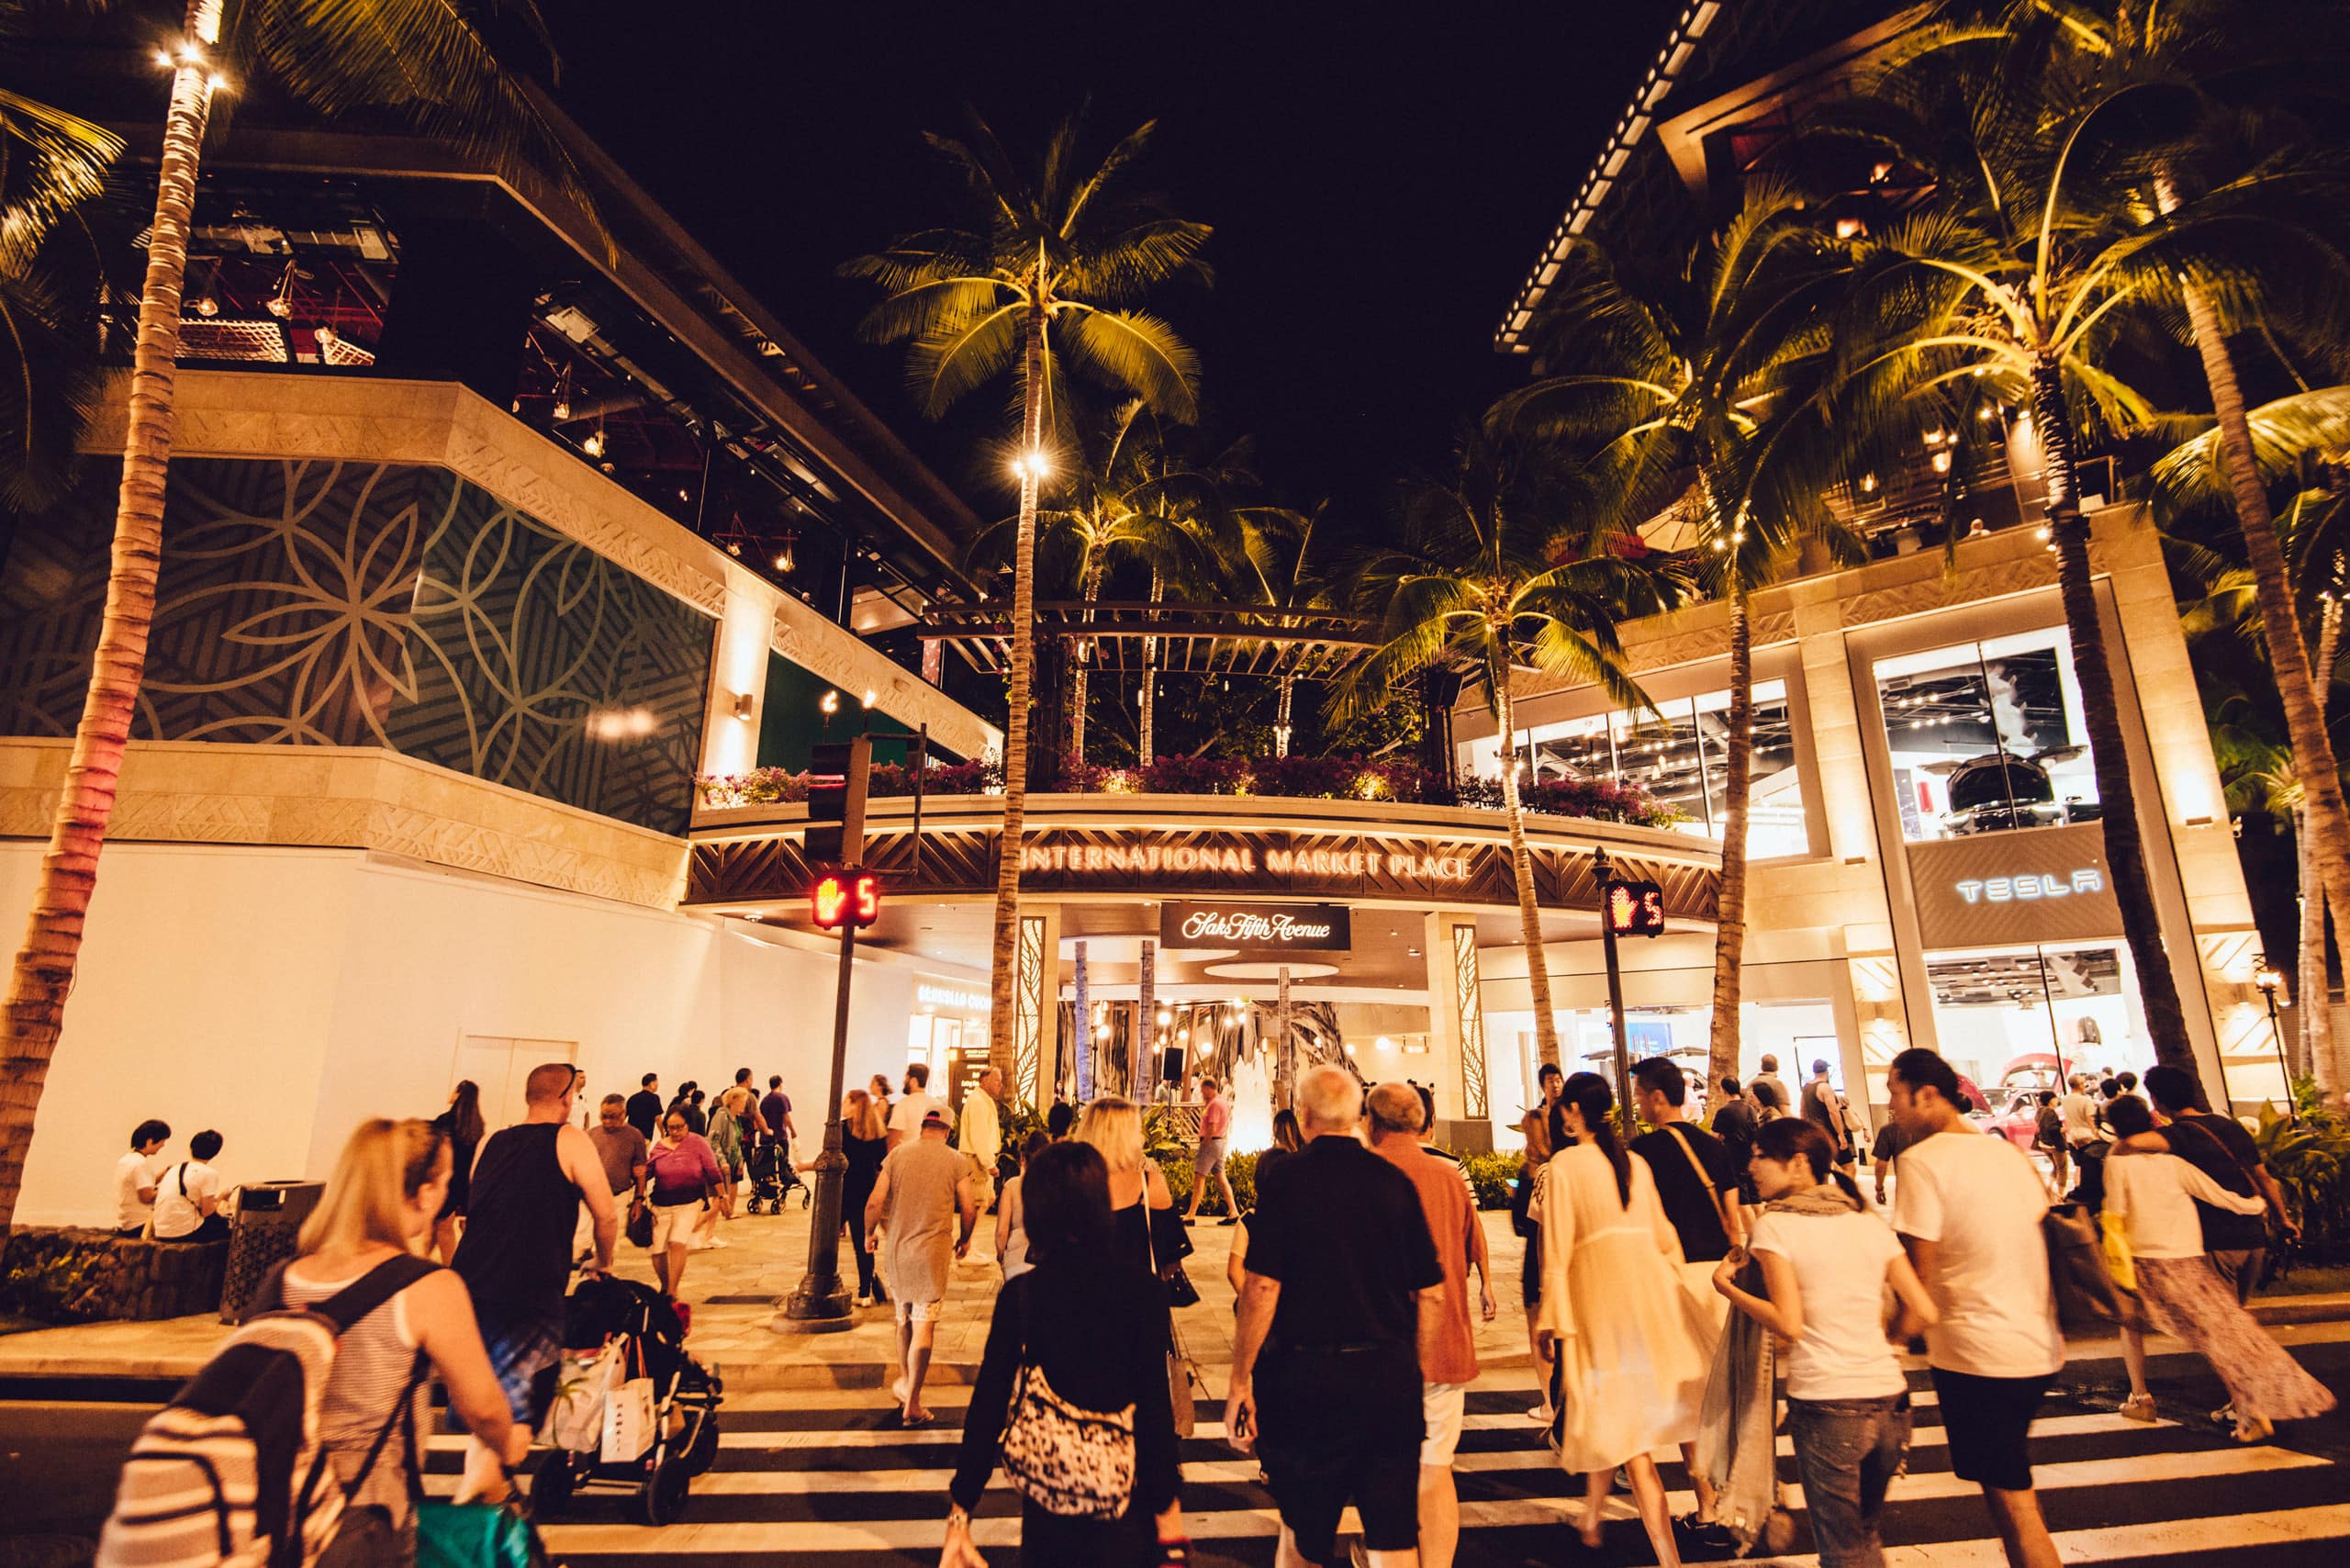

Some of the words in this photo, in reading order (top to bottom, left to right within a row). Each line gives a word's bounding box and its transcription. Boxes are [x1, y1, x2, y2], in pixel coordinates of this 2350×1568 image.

[1020, 845, 1256, 871] INTERNATIONAL
[1266, 849, 1382, 874] MARKET
[1390, 854, 1472, 879] PLACE
[857, 877, 876, 915] 5
[1955, 869, 2102, 903] TESLA
[1643, 891, 1662, 926] 5
[1181, 912, 1232, 939] Saks
[1225, 913, 1270, 940] Fifth
[1259, 913, 1330, 941] Avenue
